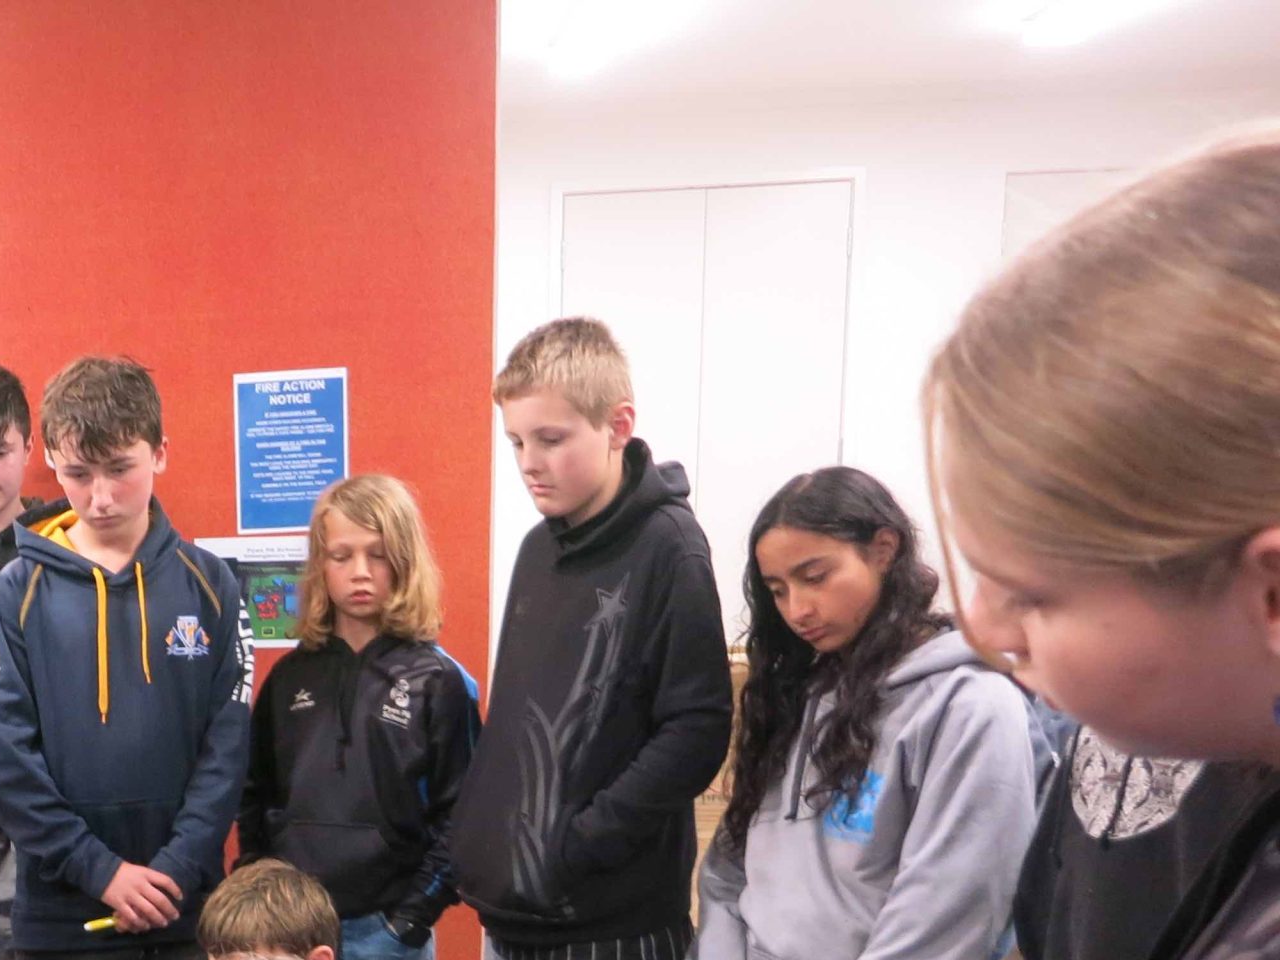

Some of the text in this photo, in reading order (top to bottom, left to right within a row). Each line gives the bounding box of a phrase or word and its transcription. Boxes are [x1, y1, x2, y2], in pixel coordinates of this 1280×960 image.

[255, 379, 326, 394] FIRE ACTION
[269, 392, 312, 405] NOTICE
